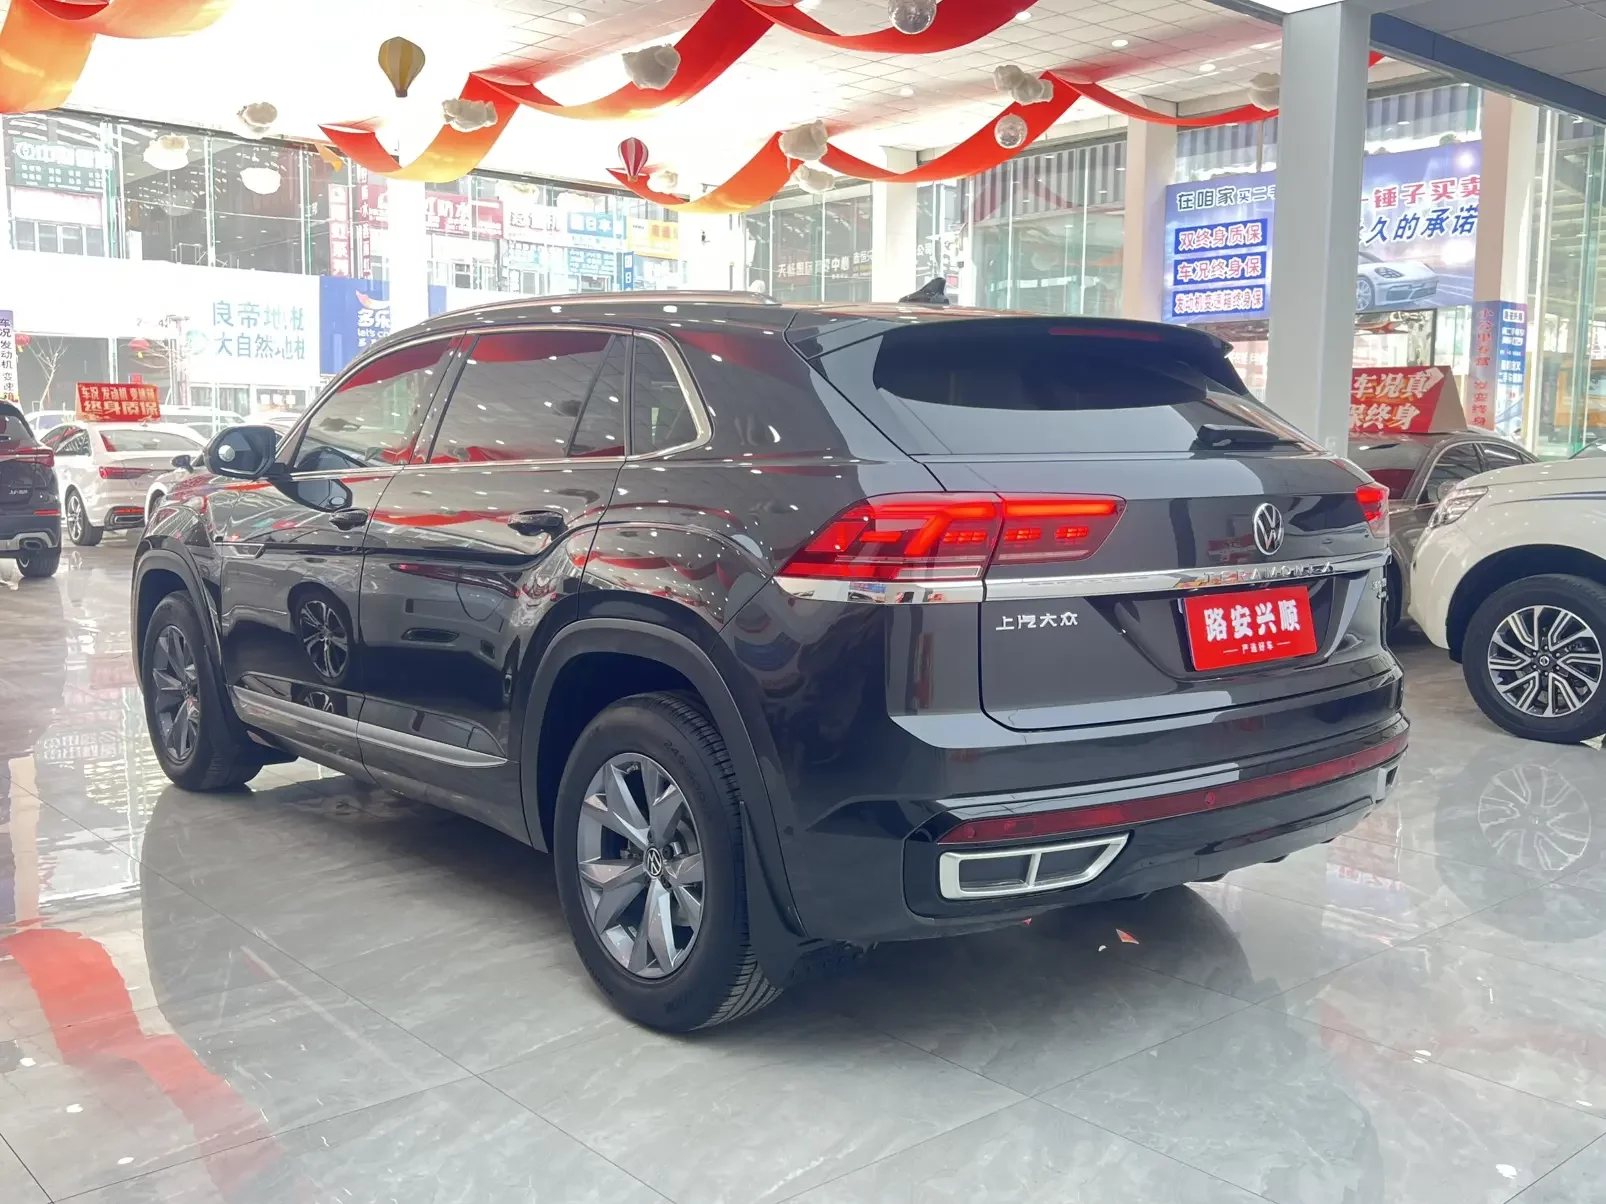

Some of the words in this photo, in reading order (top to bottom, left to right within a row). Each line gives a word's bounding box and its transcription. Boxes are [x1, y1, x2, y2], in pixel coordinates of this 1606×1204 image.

[1179, 222, 1262, 252] 双终身质保
[1359, 204, 1480, 247] 久的承诺
[1178, 256, 1262, 282] 车况终身保
[1175, 287, 1263, 314] 发动机变速箱终身保
[1350, 372, 1430, 400] 车况真
[995, 611, 1079, 631] 上汽大众
[1203, 599, 1301, 642] 路安兴顺
